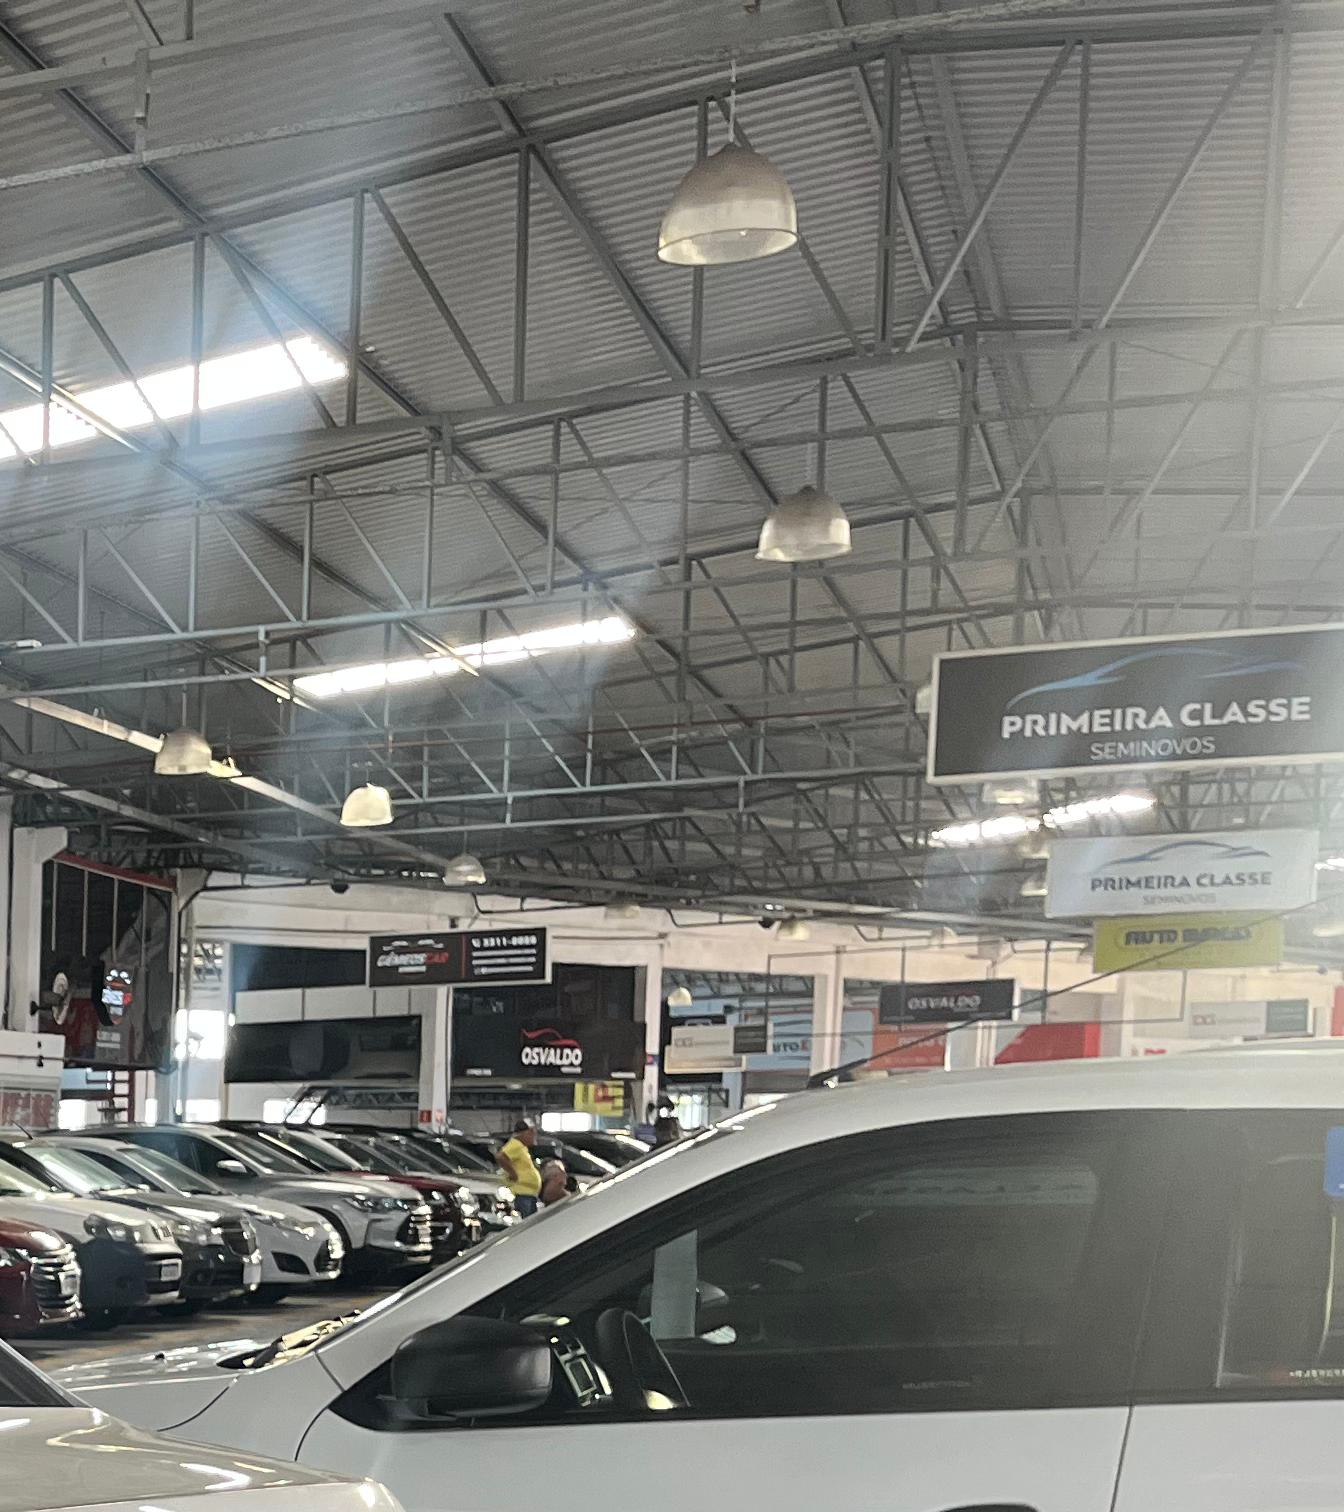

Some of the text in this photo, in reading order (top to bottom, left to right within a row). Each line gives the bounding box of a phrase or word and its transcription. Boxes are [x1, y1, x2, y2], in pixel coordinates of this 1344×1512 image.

[1001, 696, 1311, 739] PRIMEIRA CLASSE
[1090, 736, 1216, 762] SEMINOVOS
[1090, 871, 1273, 892] PRIMEIRA CLASSE
[521, 1046, 583, 1066] OSVALDO
